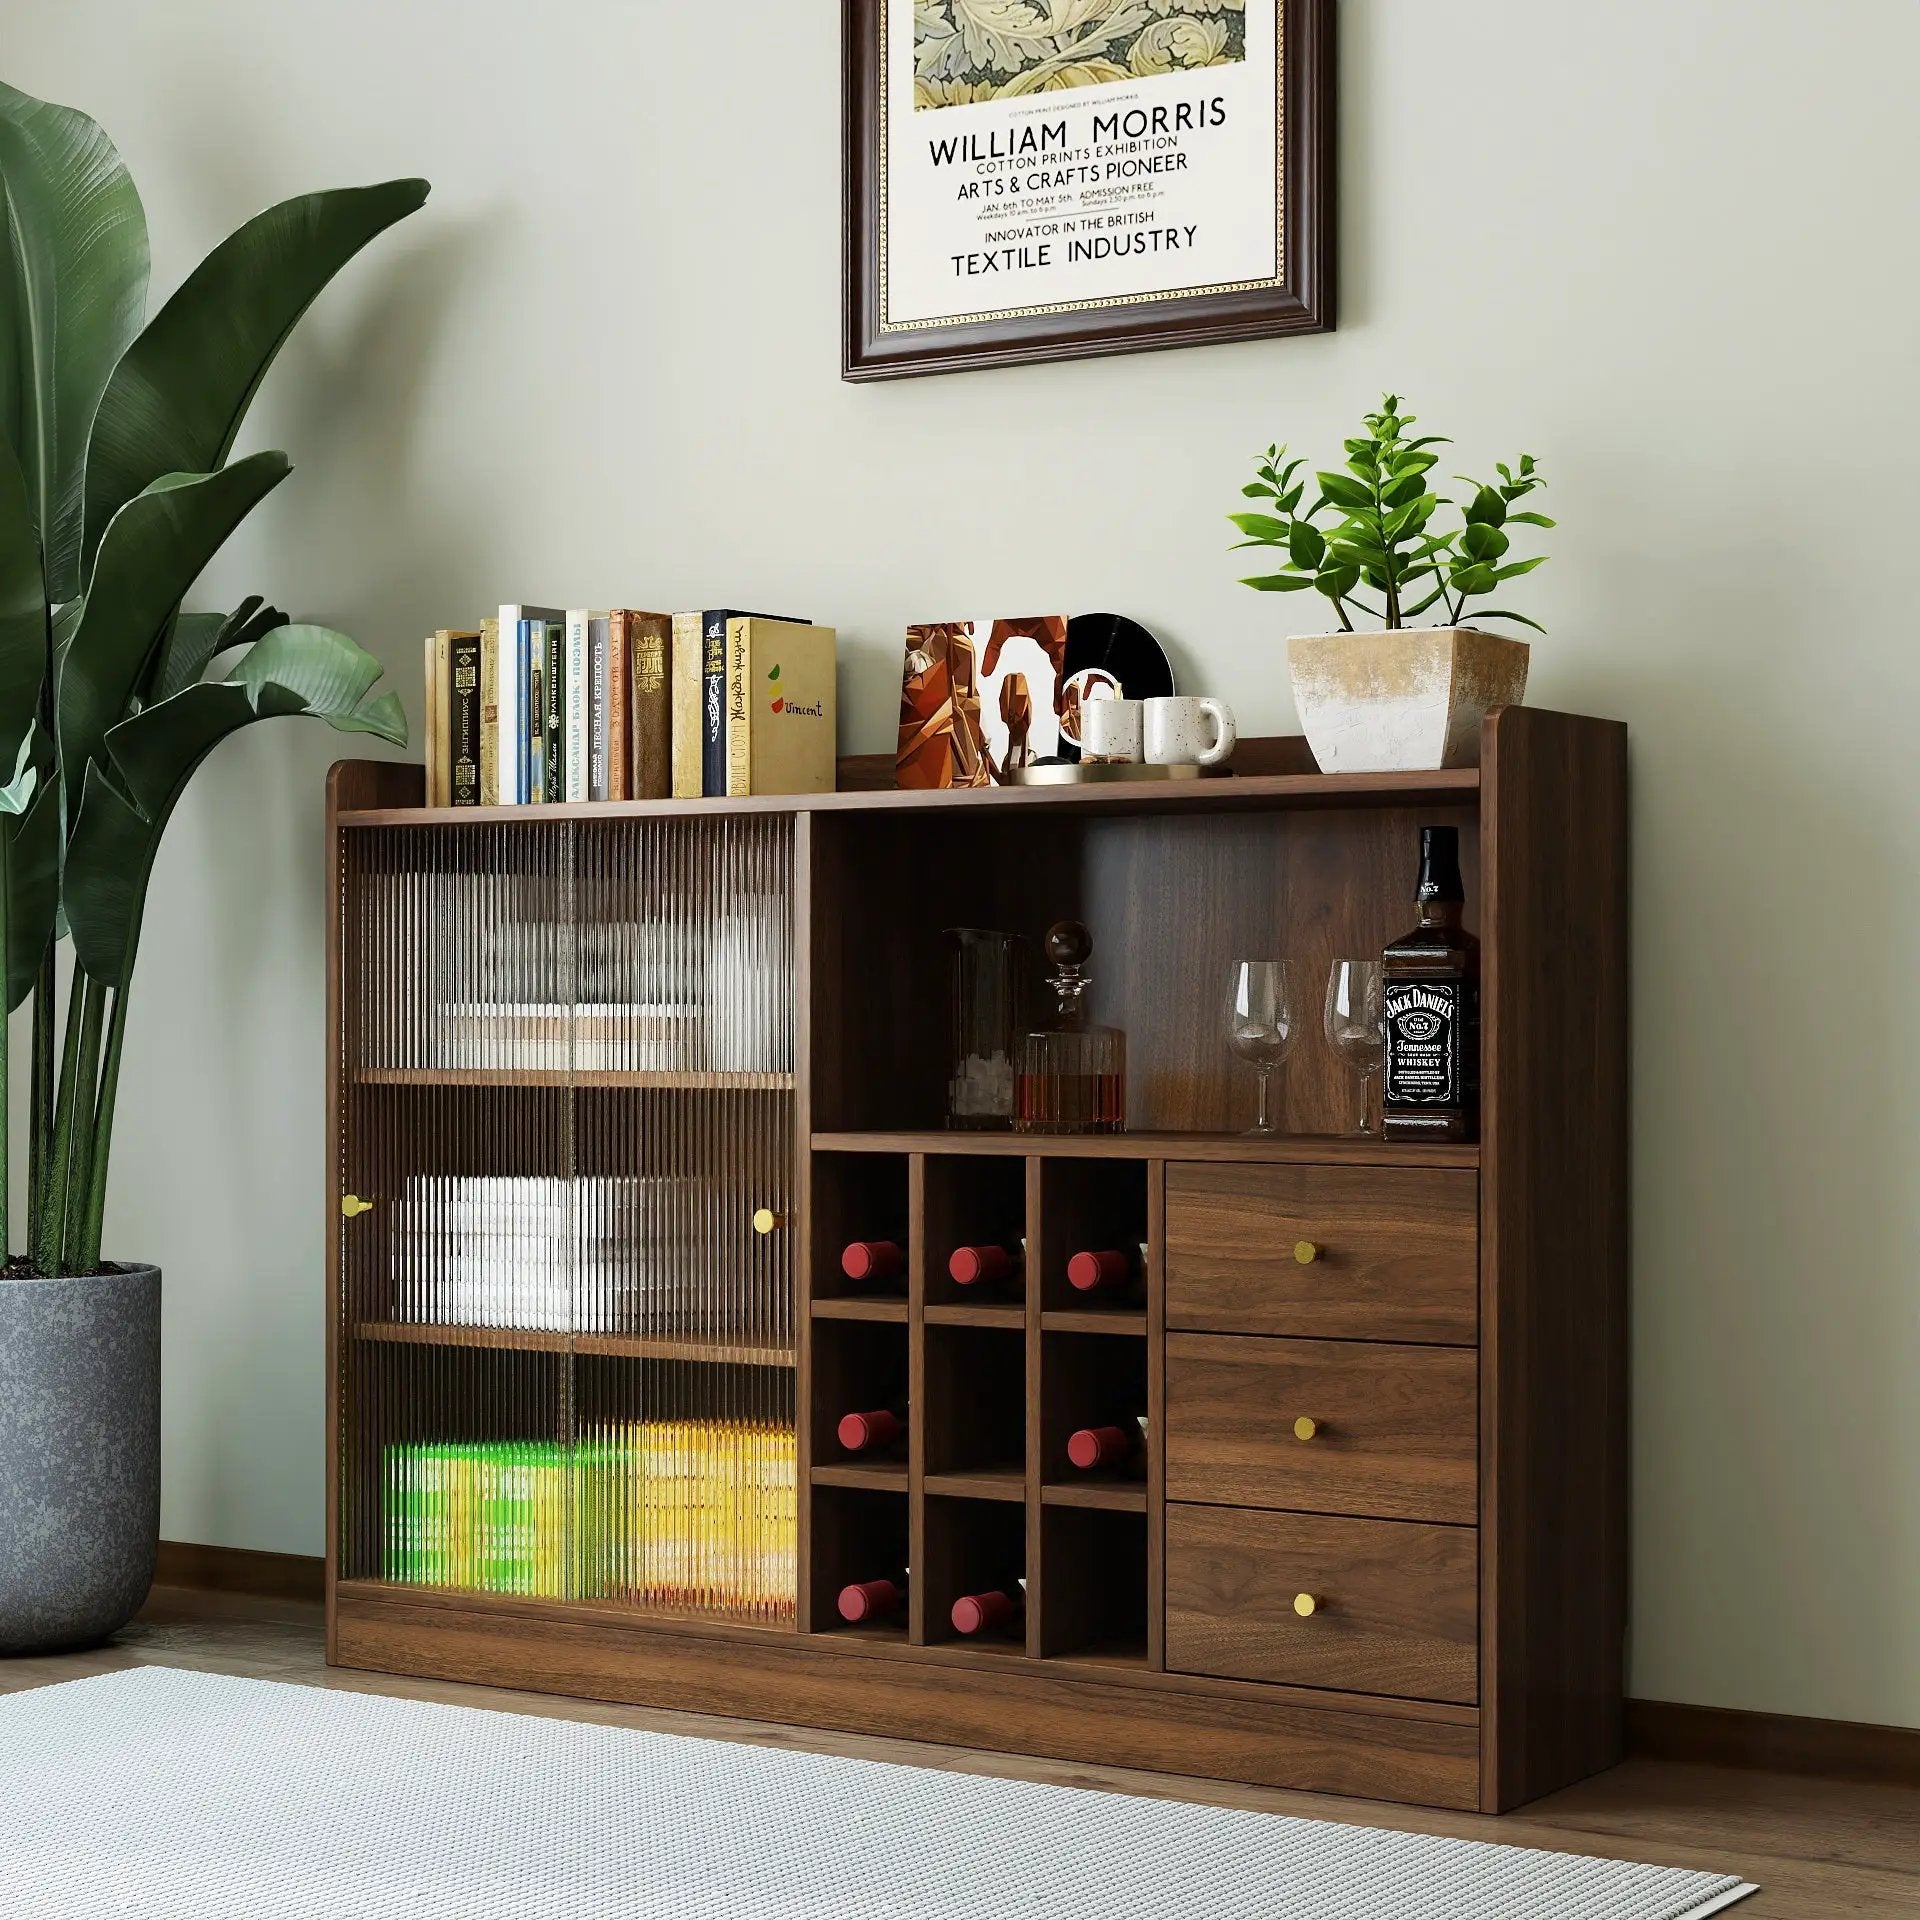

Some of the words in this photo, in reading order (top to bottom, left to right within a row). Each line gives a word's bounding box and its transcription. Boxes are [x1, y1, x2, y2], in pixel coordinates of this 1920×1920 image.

[929, 120, 1066, 166] WILLIAM
[1093, 97, 1226, 143] MORRIS
[976, 158, 1036, 175] COTTON
[1042, 148, 1090, 166] PRINTS
[1096, 136, 1178, 158] EXHIBITION
[957, 179, 1003, 200] ARTS
[1010, 176, 1020, 193] &
[1027, 165, 1100, 190] CRAFTS
[1107, 153, 1188, 179] PIONEER
[1003, 202, 1018, 210] 6th
[1021, 199, 1033, 207] TO
[1036, 196, 1055, 206] MAY
[1079, 187, 1130, 199] ADMISSION
[1131, 181, 1154, 192] FREE
[977, 212, 1008, 221] Weekdays
[985, 225, 1059, 243] INNOVATOR
[1063, 222, 1076, 233] IN
[1081, 218, 1103, 231] THE
[1108, 211, 1155, 227] BRITISH
[951, 245, 1051, 276] TEXTILE
[1068, 225, 1197, 262] INDUSTRY
[572, 624, 581, 676] ПОЭМЫ
[594, 642, 602, 699] КРЕПОСТЬ
[572, 686, 581, 720] БЛОК
[731, 673, 745, 721] Жажда
[785, 701, 823, 717] Vincent
[594, 703, 602, 750] ЛЕСНАЯ
[731, 724, 746, 758] СТОУН
[571, 724, 581, 799] АЛЕКСАНДР
[731, 763, 747, 796] РВИНГ
[1386, 994, 1413, 1018] JACK
[1413, 988, 1455, 1018] DANIEL'S
[1409, 1022, 1429, 1030] No.7
[1396, 1040, 1442, 1052] Tennessee
[1397, 1058, 1441, 1067] WHISKEY
